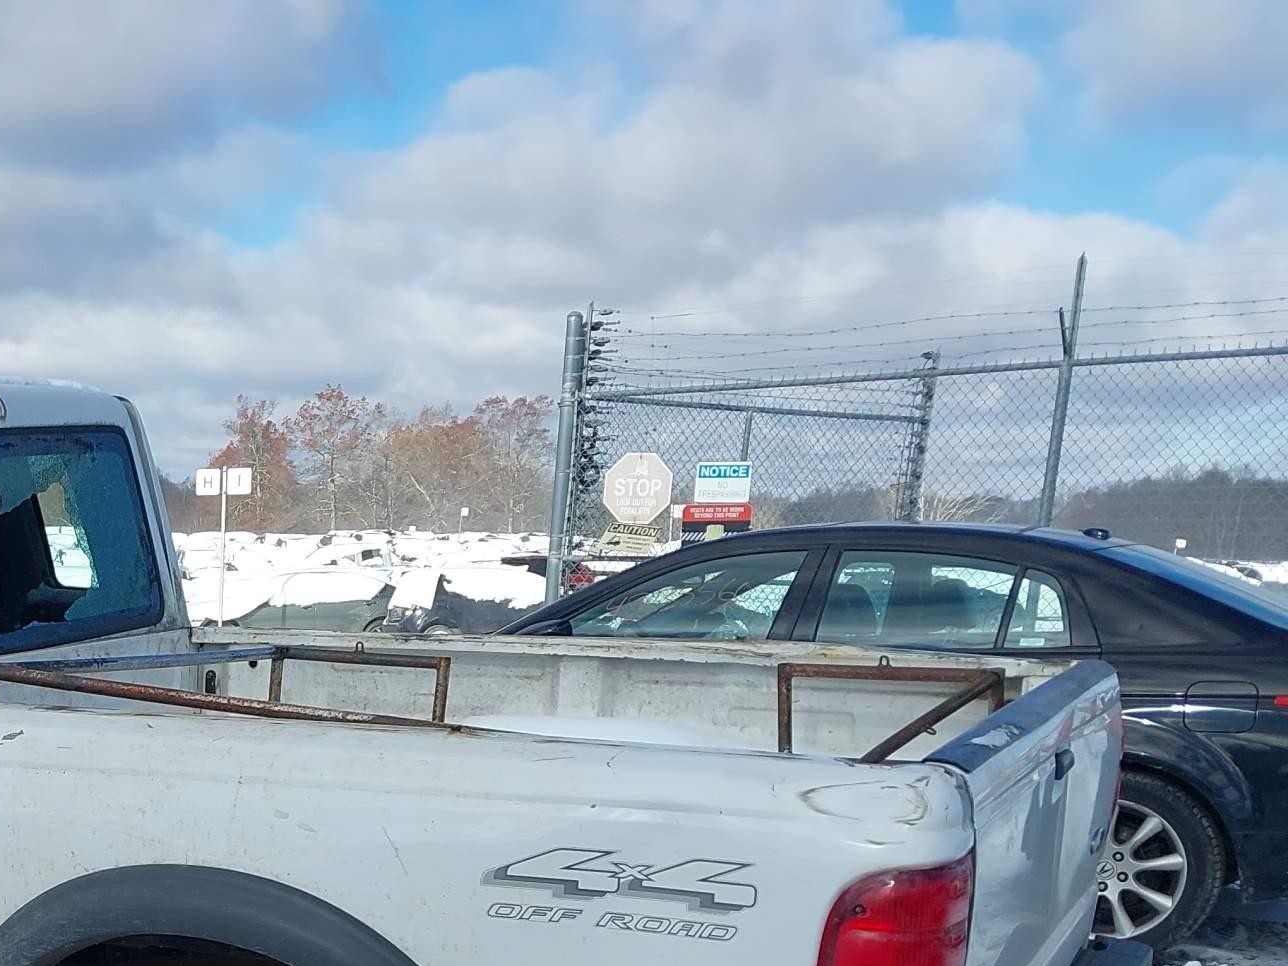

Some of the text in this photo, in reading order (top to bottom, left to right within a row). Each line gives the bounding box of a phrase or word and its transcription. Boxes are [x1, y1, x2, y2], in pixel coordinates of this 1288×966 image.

[700, 465, 748, 477] NOTICE
[614, 478, 662, 497] STOP
[717, 480, 729, 489] NO
[610, 524, 658, 538] CAUTION
[487, 903, 738, 942] OFF ROAD
